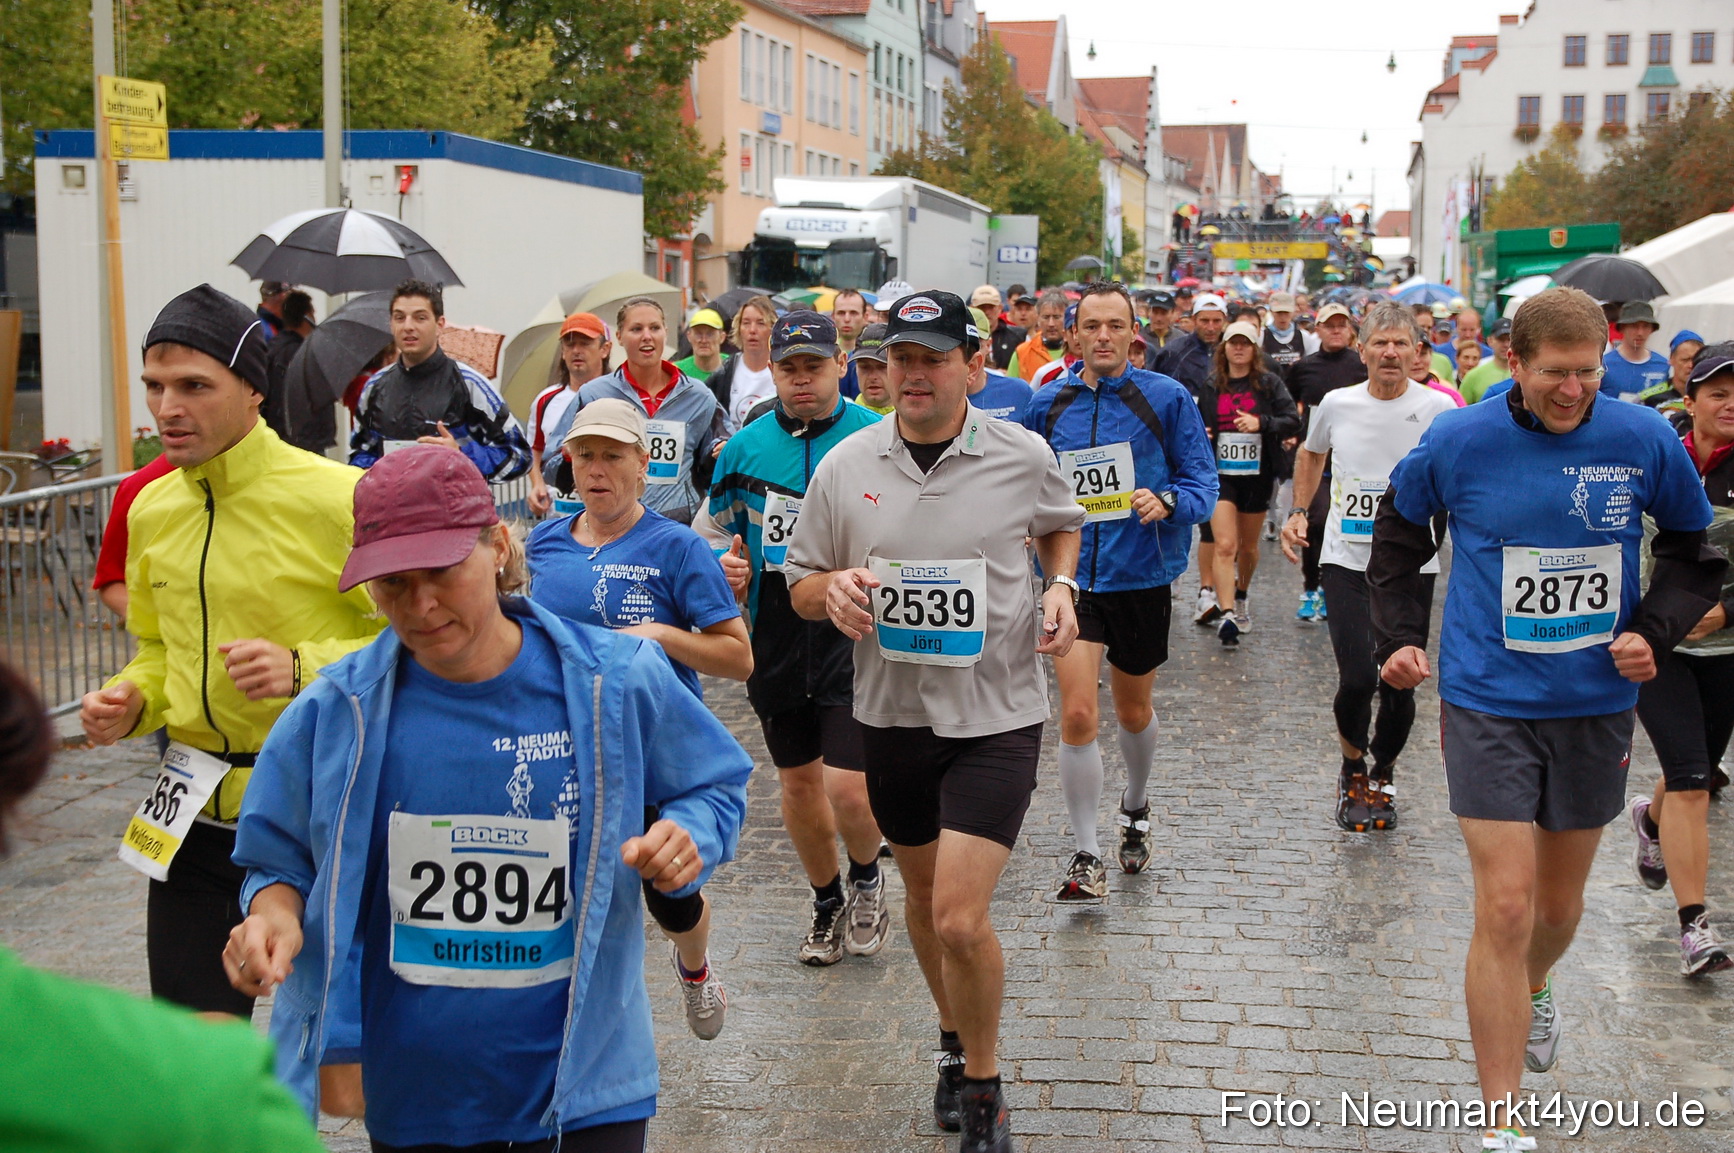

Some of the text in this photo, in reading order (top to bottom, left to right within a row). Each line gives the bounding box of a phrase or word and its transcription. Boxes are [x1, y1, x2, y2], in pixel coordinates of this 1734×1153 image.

[786, 219, 848, 232] BOCK
[998, 246, 1037, 263] BO
[1249, 246, 1288, 255] START
[650, 437, 677, 461] 83
[1075, 451, 1106, 463] BOCK
[1220, 444, 1257, 460] 3018
[1562, 466, 1644, 477] 12. NEUMARKTER
[1578, 474, 1630, 482] STADTLAUF
[1072, 465, 1121, 496] 294
[1539, 554, 1586, 566] BOCK
[601, 571, 648, 582] STADTLAUF
[604, 564, 660, 577] NEUMARKTER
[901, 567, 948, 577] BOCK
[1515, 572, 1609, 614] 2873
[880, 586, 975, 628] 2539
[1530, 621, 1590, 638] Joachim
[910, 635, 942, 654] Jörg
[492, 731, 573, 752] 12. NEUMA
[452, 826, 528, 846] BOCK
[410, 861, 568, 926] 2894
[433, 938, 542, 963] christine
